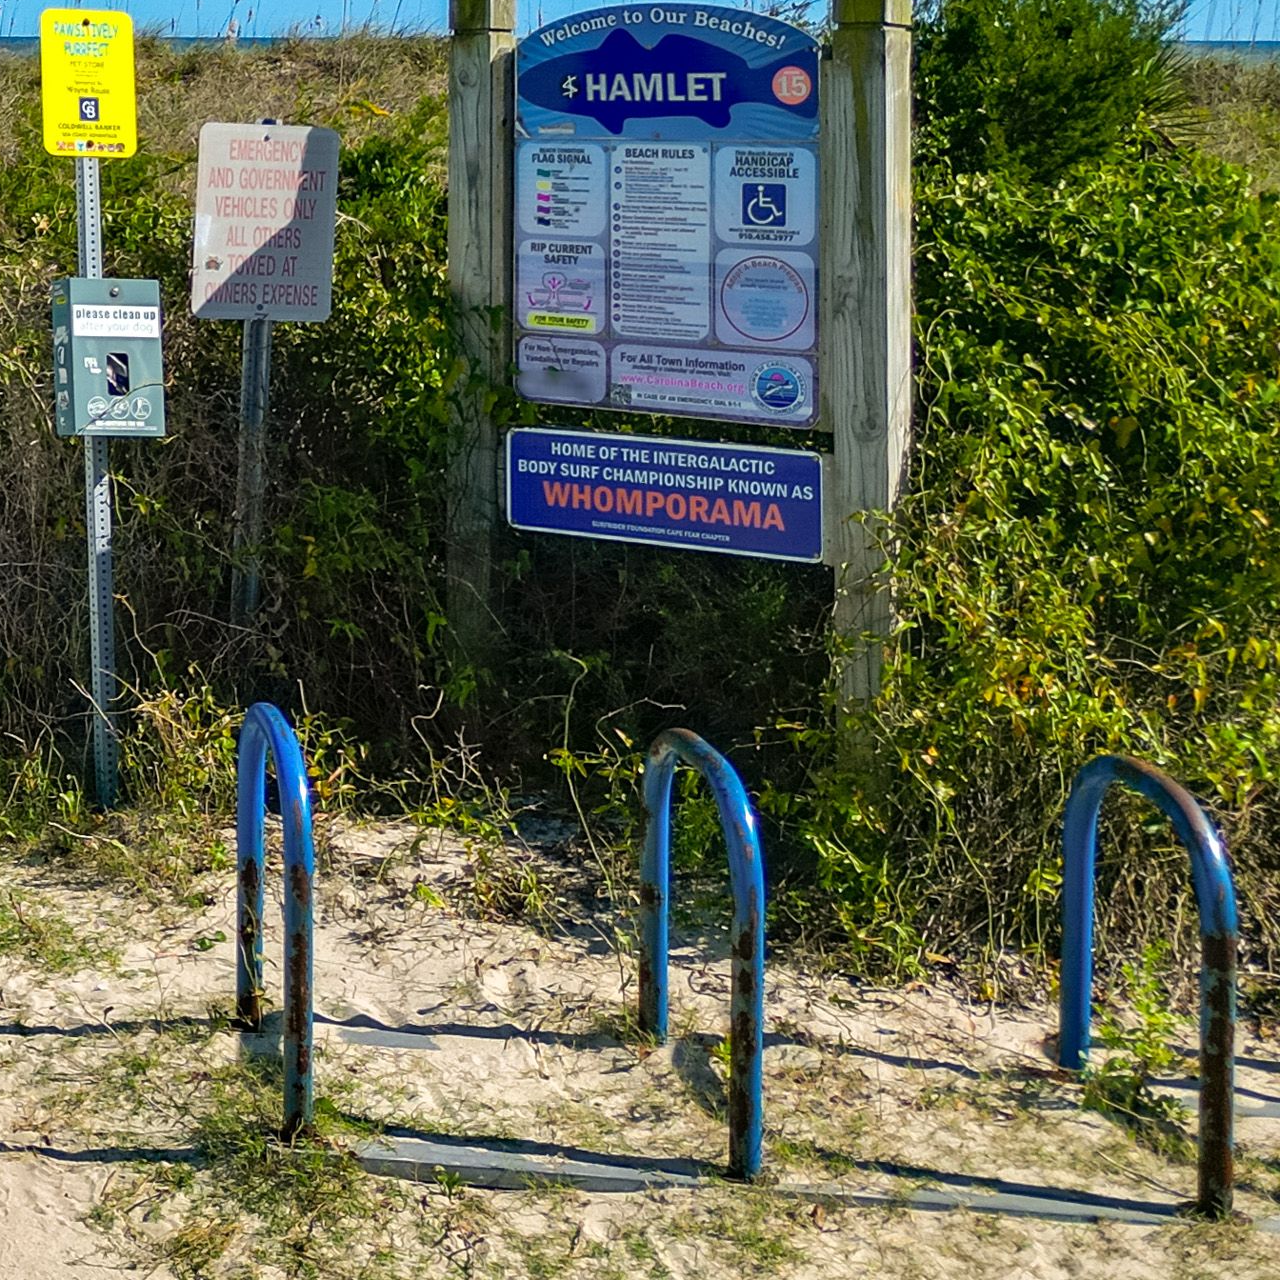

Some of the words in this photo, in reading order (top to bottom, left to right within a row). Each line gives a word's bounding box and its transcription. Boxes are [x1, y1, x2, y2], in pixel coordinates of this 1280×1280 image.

[540, 12, 617, 47] Welcome
[624, 10, 643, 24] to
[650, 8, 687, 24] Our
[694, 11, 786, 50] Beaches!
[586, 72, 727, 102] HAMLET
[777, 74, 807, 98] 15
[229, 139, 307, 162] EMERGENCY
[532, 153, 555, 164] FLAG
[557, 154, 592, 165] SIGNAL
[625, 148, 659, 158] BEACH
[661, 149, 695, 159] RULES
[735, 156, 794, 167] HANDICAP
[208, 168, 234, 188] AND
[239, 169, 326, 192] GOVERNMENT
[729, 167, 799, 178] ACCESSIBLE
[215, 196, 278, 219] VEHICLES
[283, 199, 317, 220] ONLY
[226, 226, 247, 247] ALL
[252, 227, 301, 249] OTHERS
[530, 242, 547, 252] RIP
[548, 243, 593, 254] CURRENT
[226, 255, 276, 276] TOWED
[281, 256, 298, 276] AT
[544, 254, 579, 265] SAFETY
[205, 283, 257, 304] OWNERS
[262, 284, 318, 306] EXPENSE
[76, 308, 110, 319] please
[113, 309, 141, 320] clean
[143, 311, 156, 320] up
[132, 320, 154, 333] dog
[620, 352, 637, 363] For
[639, 354, 653, 364] All
[656, 355, 682, 367] Town
[685, 357, 746, 372] Information
[551, 442, 596, 459] HOME
[599, 446, 618, 461] OF
[621, 448, 649, 463] THE
[653, 451, 775, 475] INTERGALACTIC
[518, 460, 557, 476] BODY
[560, 463, 599, 479] SURF
[603, 467, 724, 491] CHAMPIONSHIP
[728, 479, 788, 498] KNOWN
[791, 485, 814, 501] AS
[542, 480, 785, 532] WHOMPORAMA
